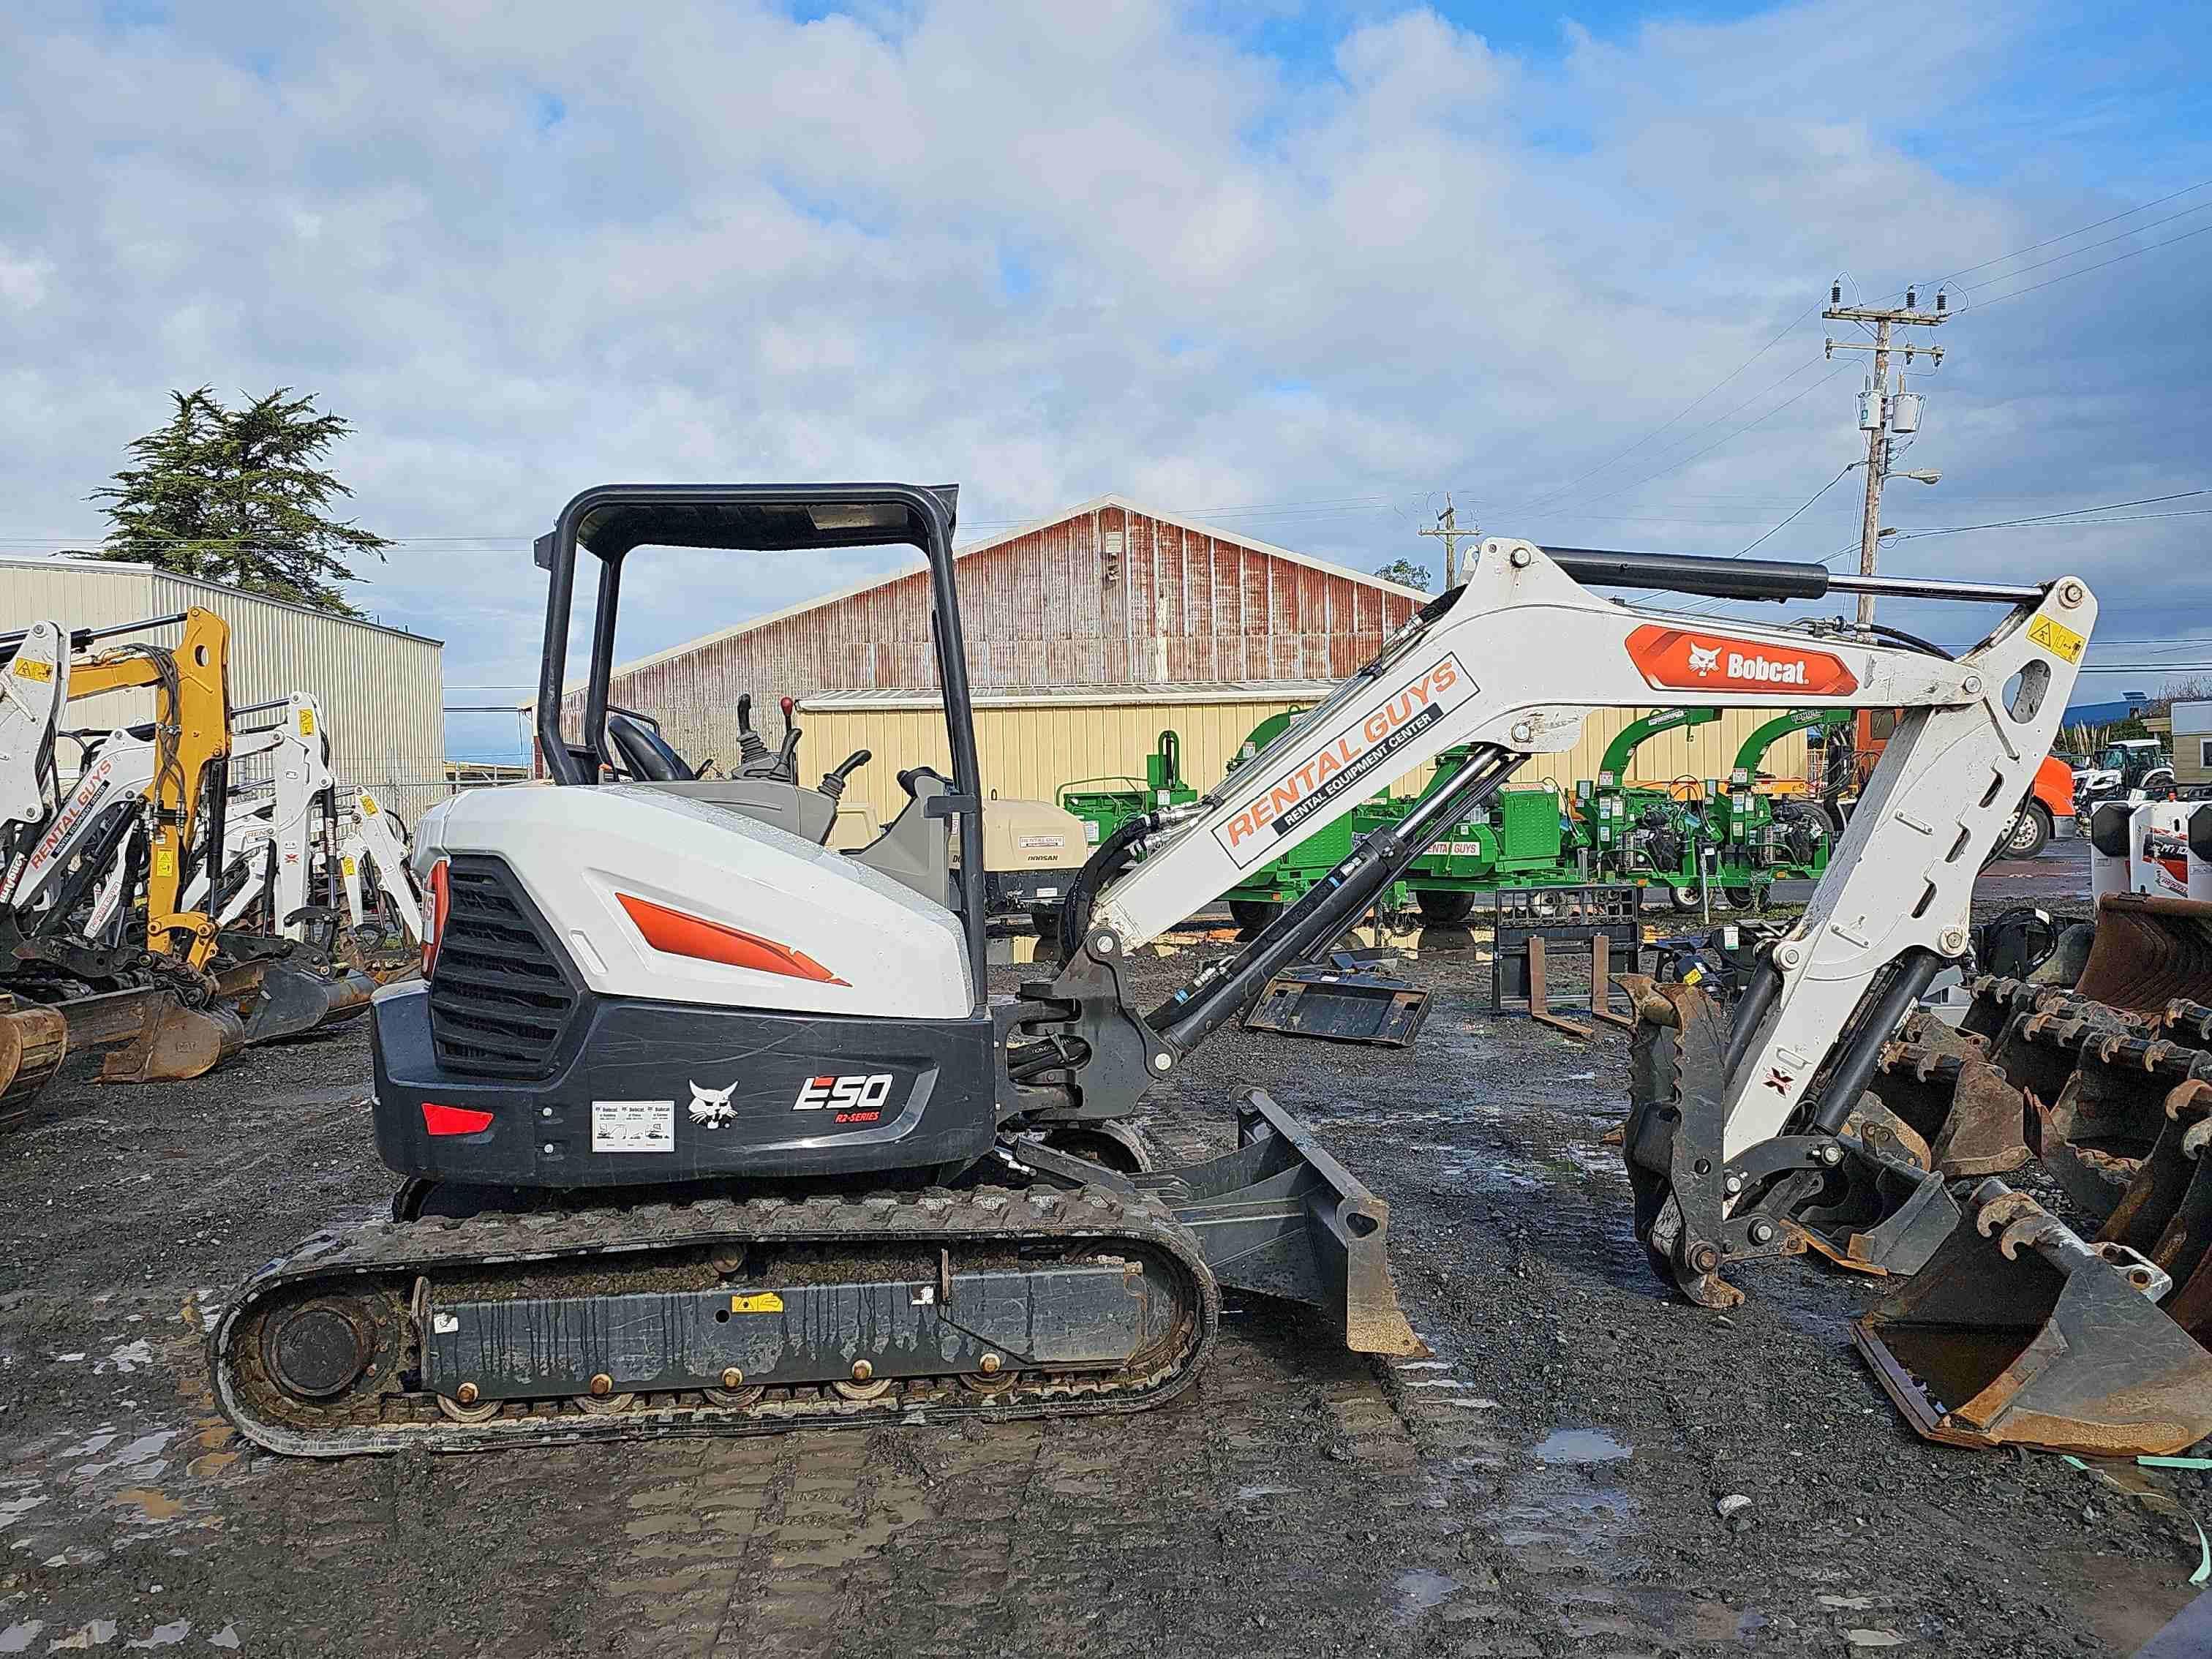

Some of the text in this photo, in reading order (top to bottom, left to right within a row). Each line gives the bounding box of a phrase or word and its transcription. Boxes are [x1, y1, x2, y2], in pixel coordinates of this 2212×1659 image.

[1227, 661, 1458, 849] RENTAL GUYS
[1283, 712, 1433, 827] RENTAL EQUIPMENT CENTER
[30, 759, 113, 870] RENTAL GUYS
[54, 831, 72, 854] RENTAL
[1454, 843, 1477, 854] GUYS
[792, 1073, 894, 1110] E50
[834, 1111, 880, 1124] R2-SERIES
